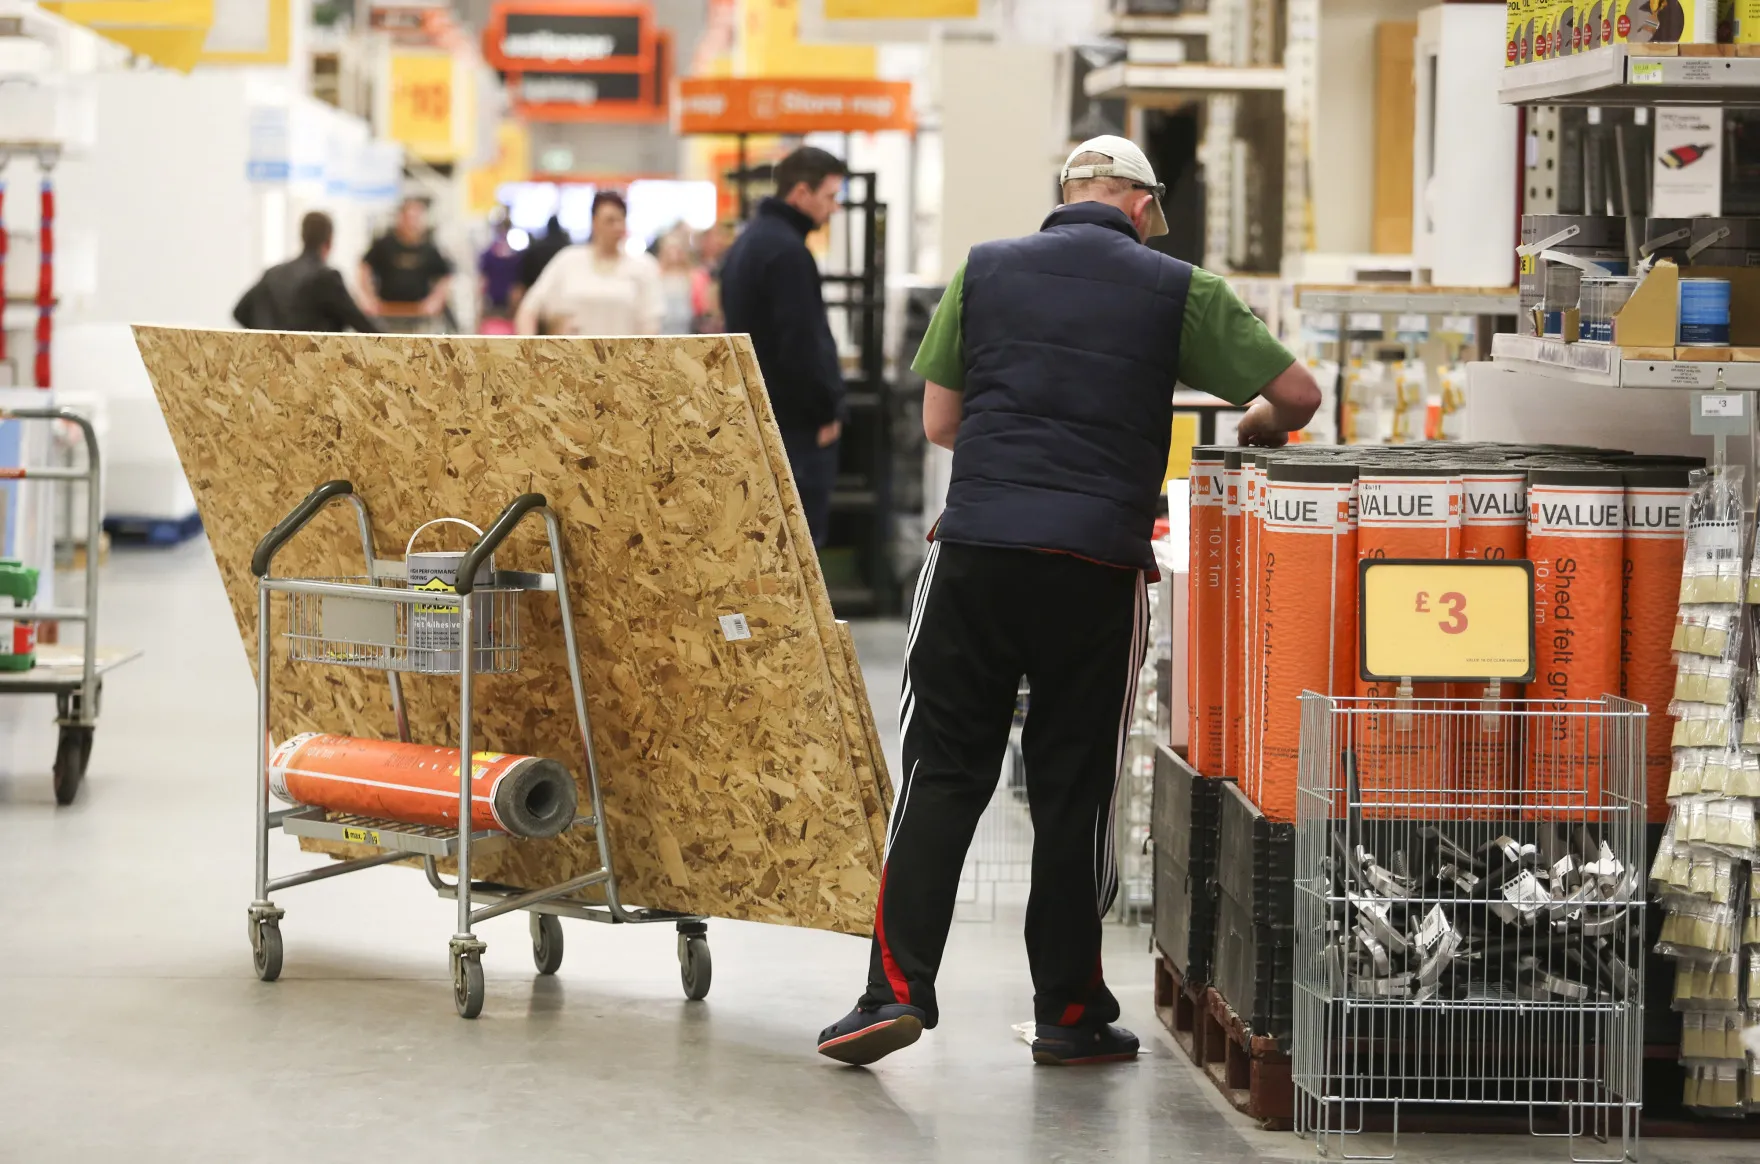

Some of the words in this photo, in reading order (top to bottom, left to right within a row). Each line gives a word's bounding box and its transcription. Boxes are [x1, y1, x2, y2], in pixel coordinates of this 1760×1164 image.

[1361, 495, 1433, 517] VALUE
[1469, 493, 1526, 514] VALU
[1542, 504, 1618, 526] VALUE
[1536, 559, 1549, 578] 10
[1536, 583, 1546, 593] x
[1555, 557, 1577, 620] Shed
[1553, 628, 1574, 664] felt
